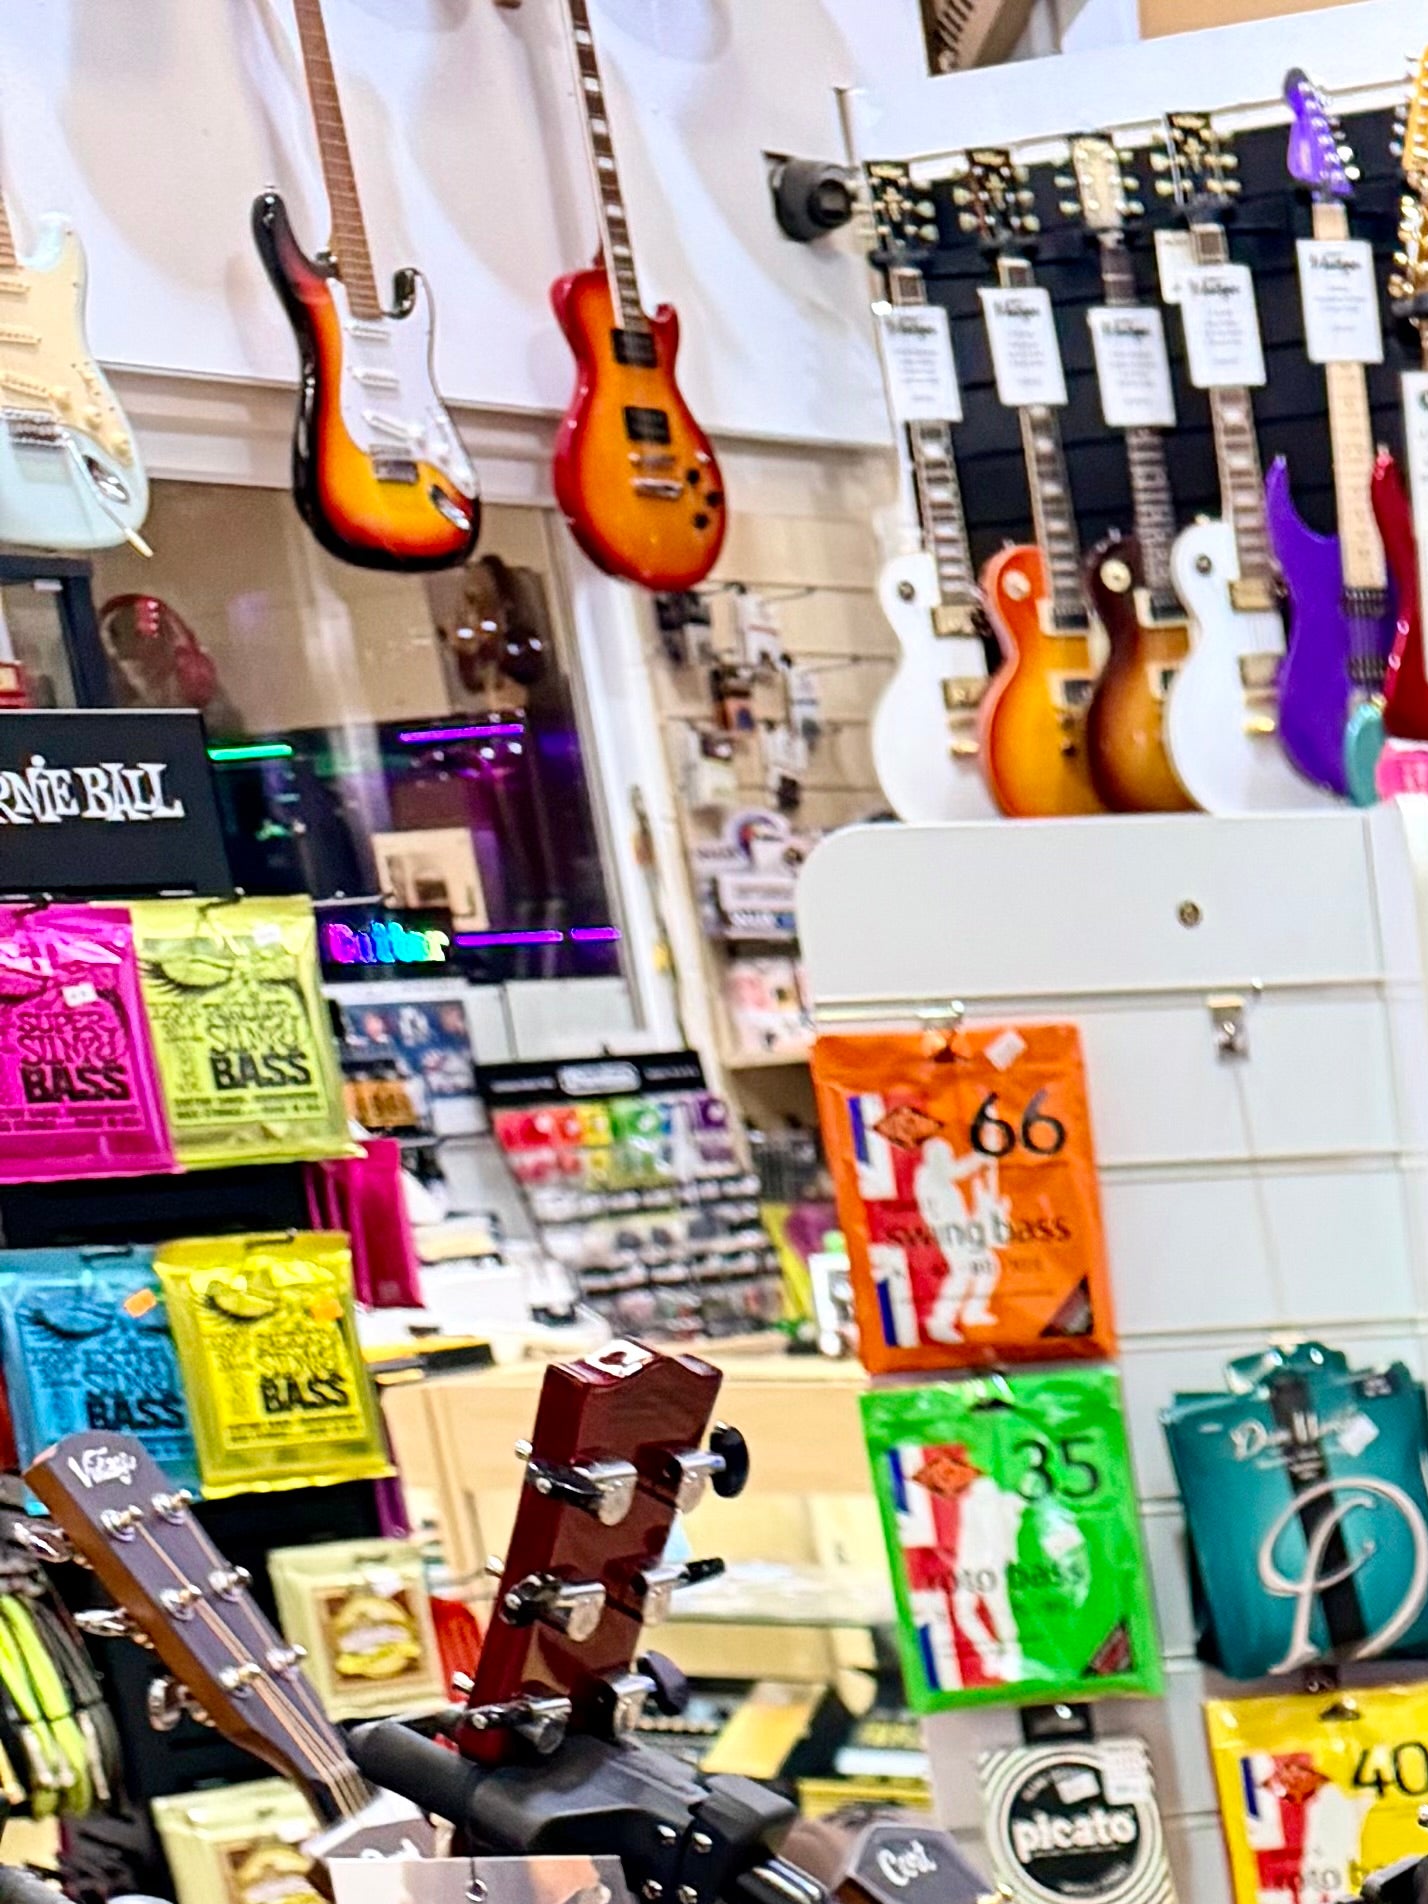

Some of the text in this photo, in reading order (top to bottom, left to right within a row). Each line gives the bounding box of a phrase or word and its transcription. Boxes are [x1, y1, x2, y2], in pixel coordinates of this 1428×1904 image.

[0, 755, 185, 824] RNIE BALL
[21, 1063, 131, 1104] BASS
[209, 1051, 313, 1091] BASS
[969, 1088, 1067, 1158] 66
[991, 1210, 1072, 1246] bass
[260, 1372, 350, 1414] BASS
[1014, 1436, 1099, 1502] 35
[1011, 1804, 1138, 1865] picato
